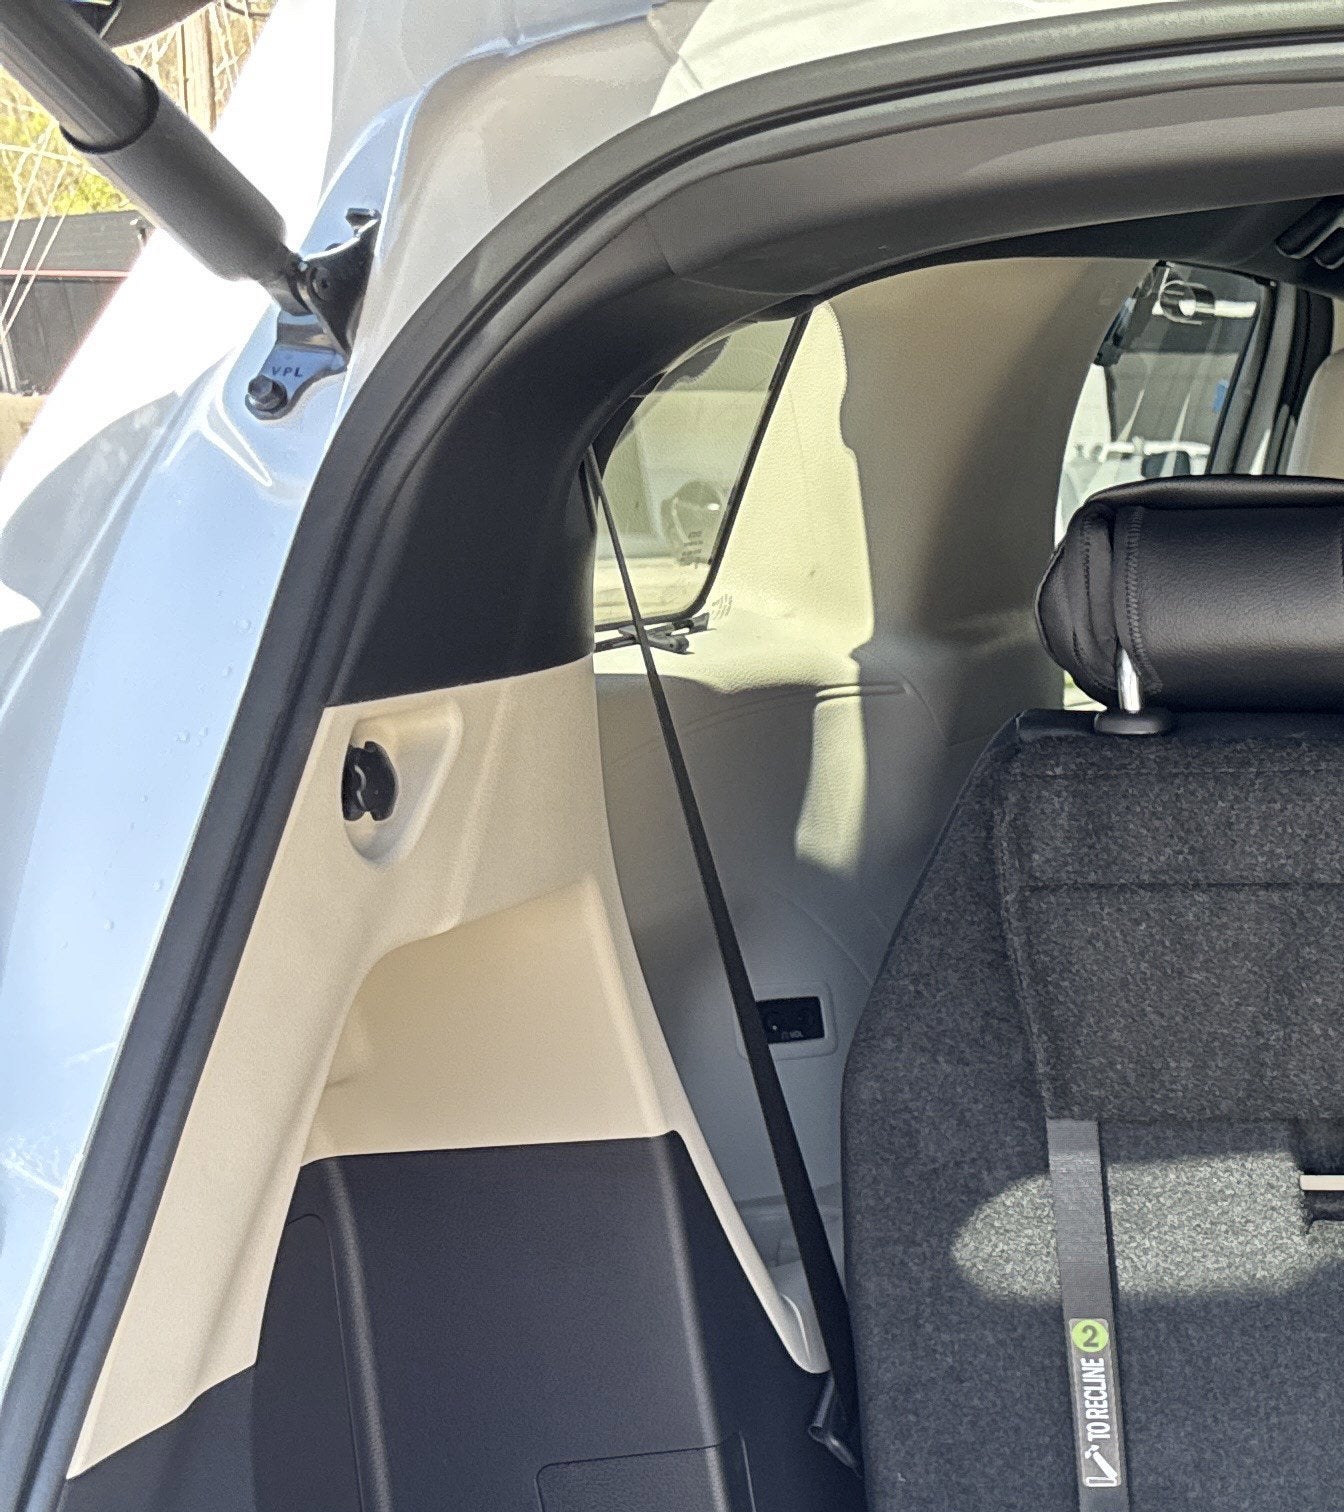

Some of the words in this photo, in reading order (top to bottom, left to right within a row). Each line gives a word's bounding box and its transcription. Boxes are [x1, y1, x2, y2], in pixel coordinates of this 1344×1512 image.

[271, 366, 303, 378] VPL
[1082, 1325, 1099, 1348] 2
[1080, 1358, 1109, 1419] RECLINE
[1087, 1421, 1110, 1442] TO
